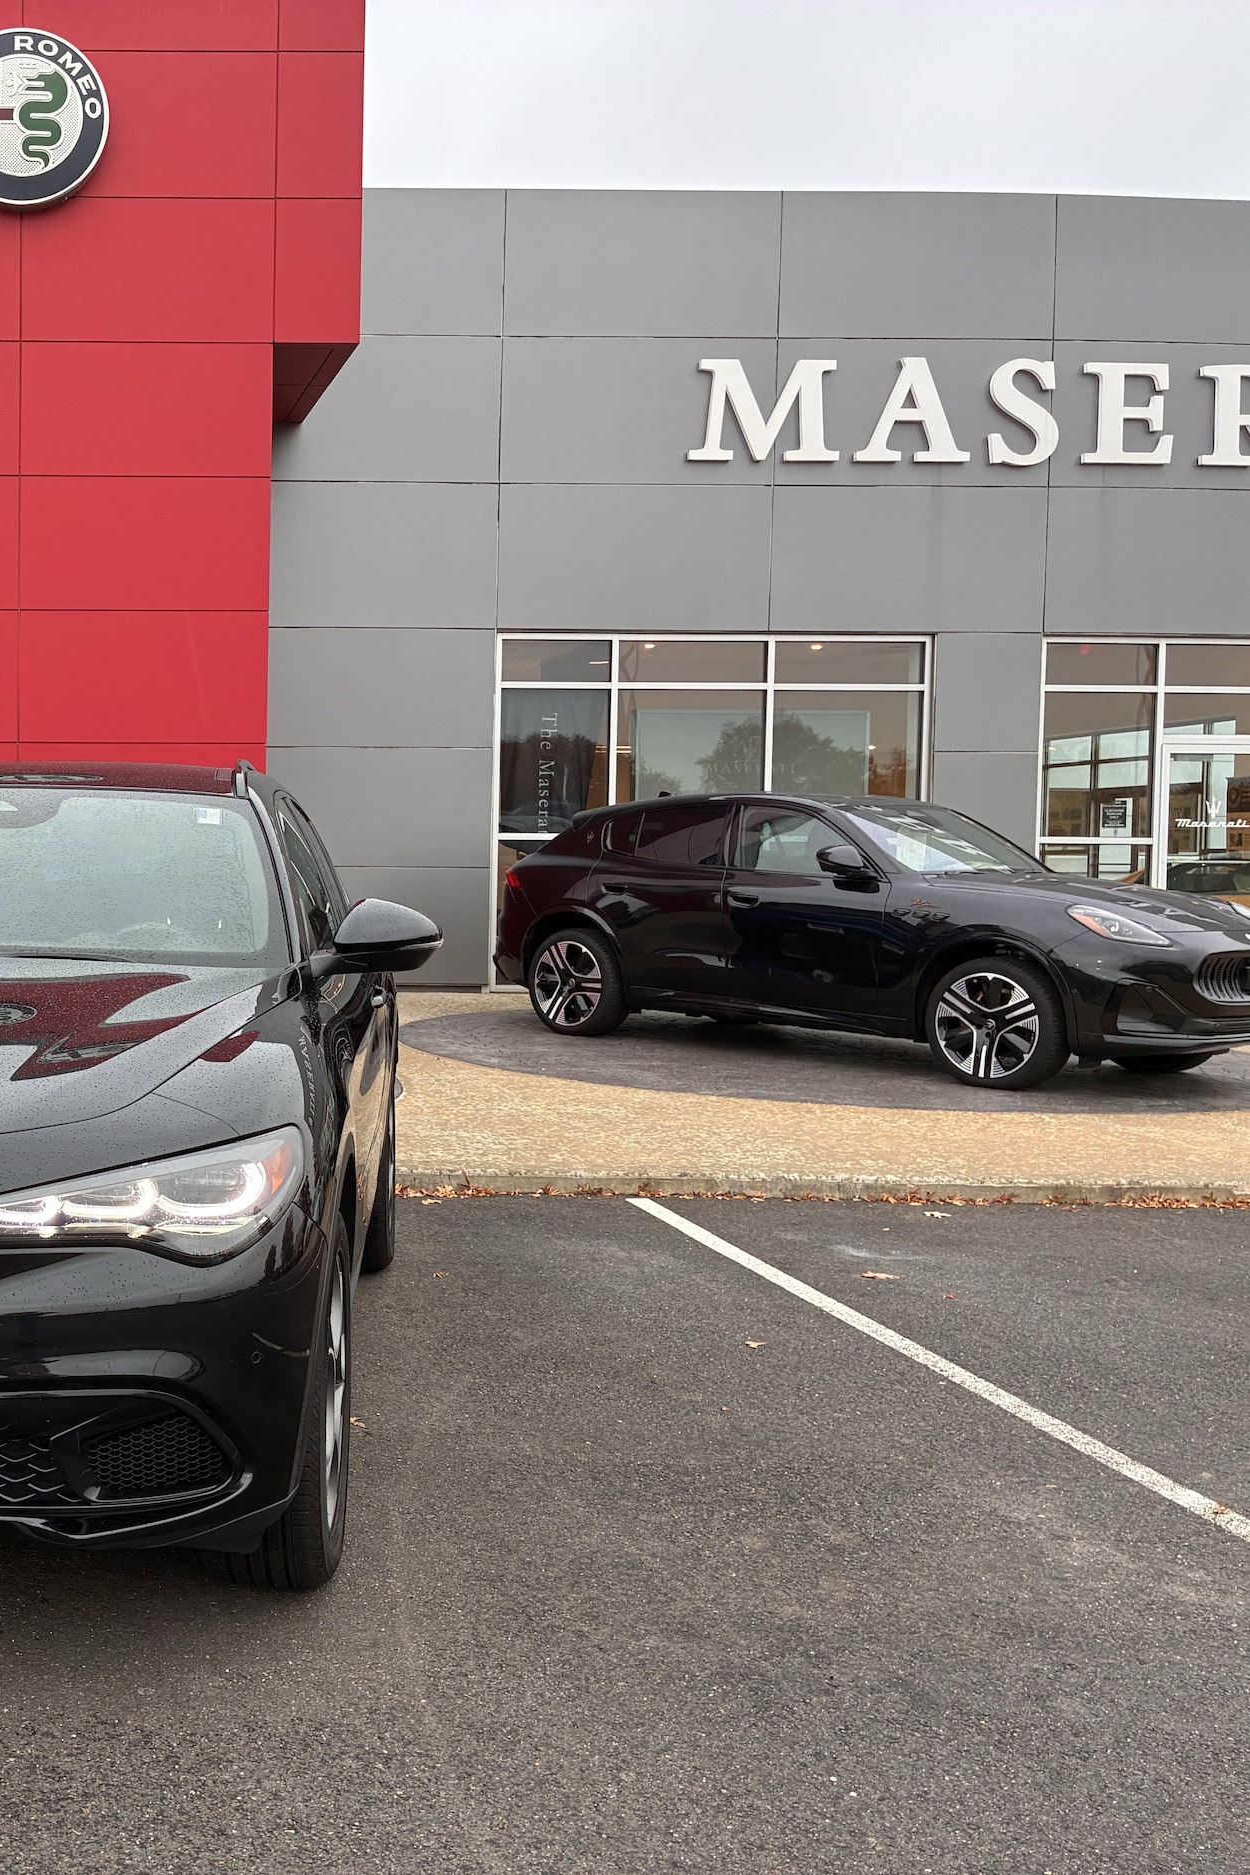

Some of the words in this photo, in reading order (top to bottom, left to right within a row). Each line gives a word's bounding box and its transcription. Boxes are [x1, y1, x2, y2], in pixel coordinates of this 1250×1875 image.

[13, 35, 102, 119] ROMEO
[539, 712, 558, 750] The
[537, 759, 556, 834] Masera
[1174, 818, 1250, 828] Maserati
